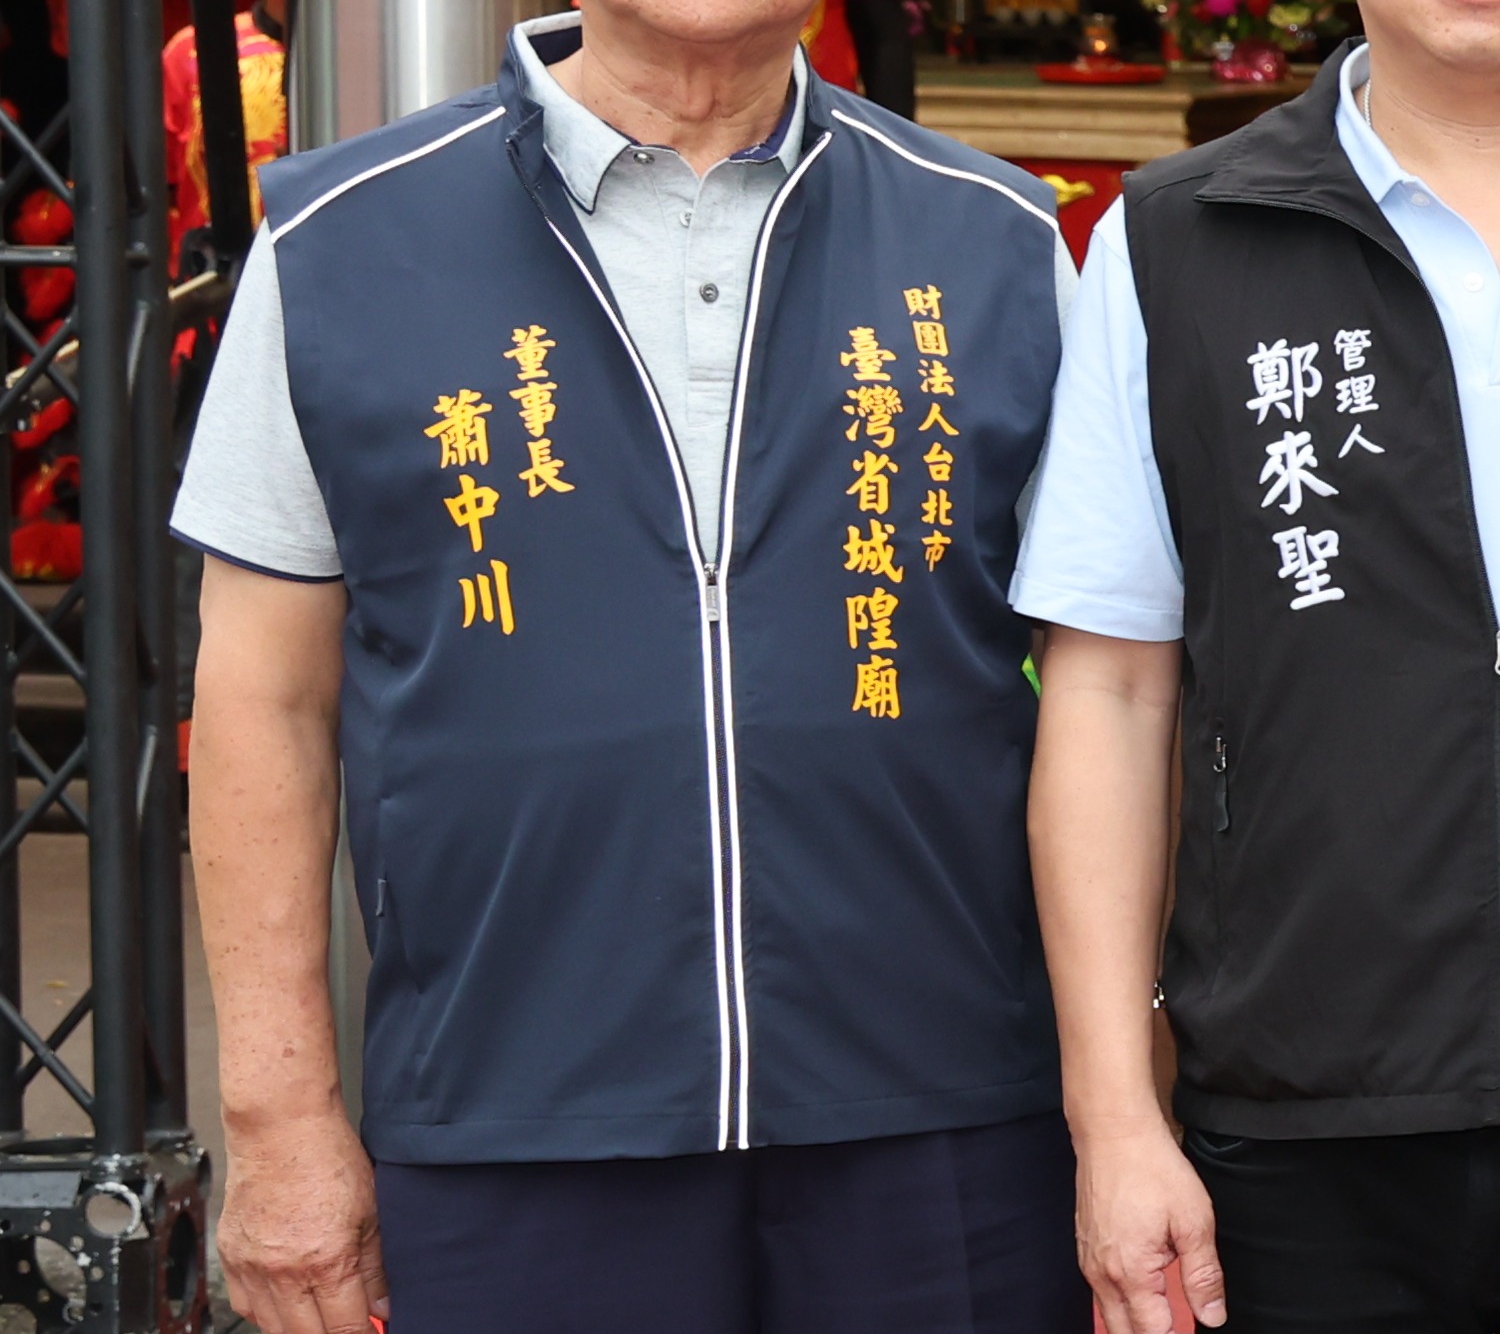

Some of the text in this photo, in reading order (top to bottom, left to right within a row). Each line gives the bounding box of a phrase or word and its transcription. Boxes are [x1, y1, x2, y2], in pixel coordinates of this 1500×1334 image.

[424, 389, 516, 637] 蕭中川
[504, 325, 575, 498] 董事長
[839, 325, 905, 721] 臺灣省城隍廟
[902, 284, 960, 573] 財團法人台北市
[1246, 336, 1346, 611] 鄭來聖
[1333, 327, 1385, 459] 管理人
